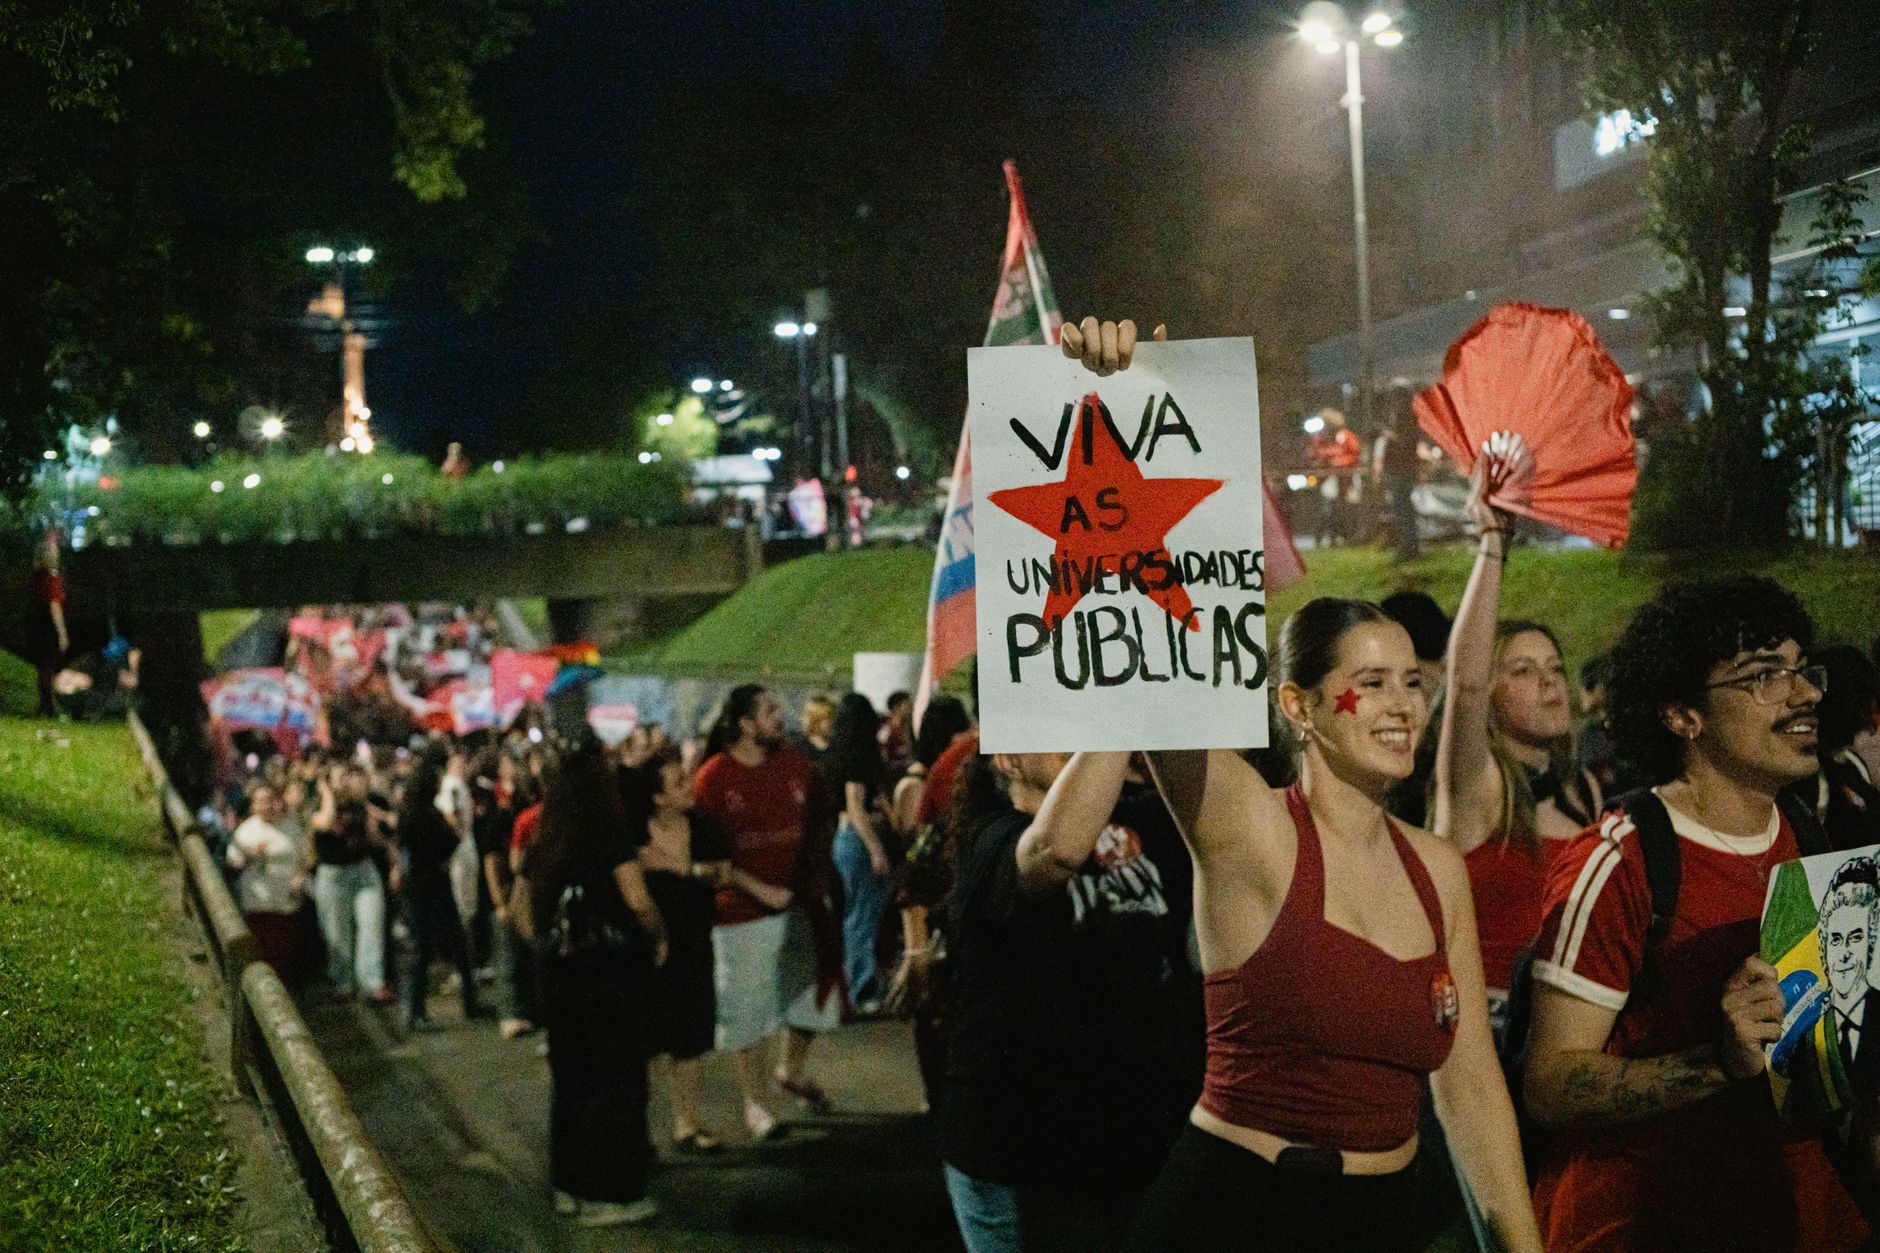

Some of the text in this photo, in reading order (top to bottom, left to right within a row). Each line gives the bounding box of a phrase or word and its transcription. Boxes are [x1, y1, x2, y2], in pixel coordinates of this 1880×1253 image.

[1009, 391, 1202, 470] VIVA
[1060, 486, 1130, 533] AS
[1006, 602, 1267, 690] PUBLICAS
